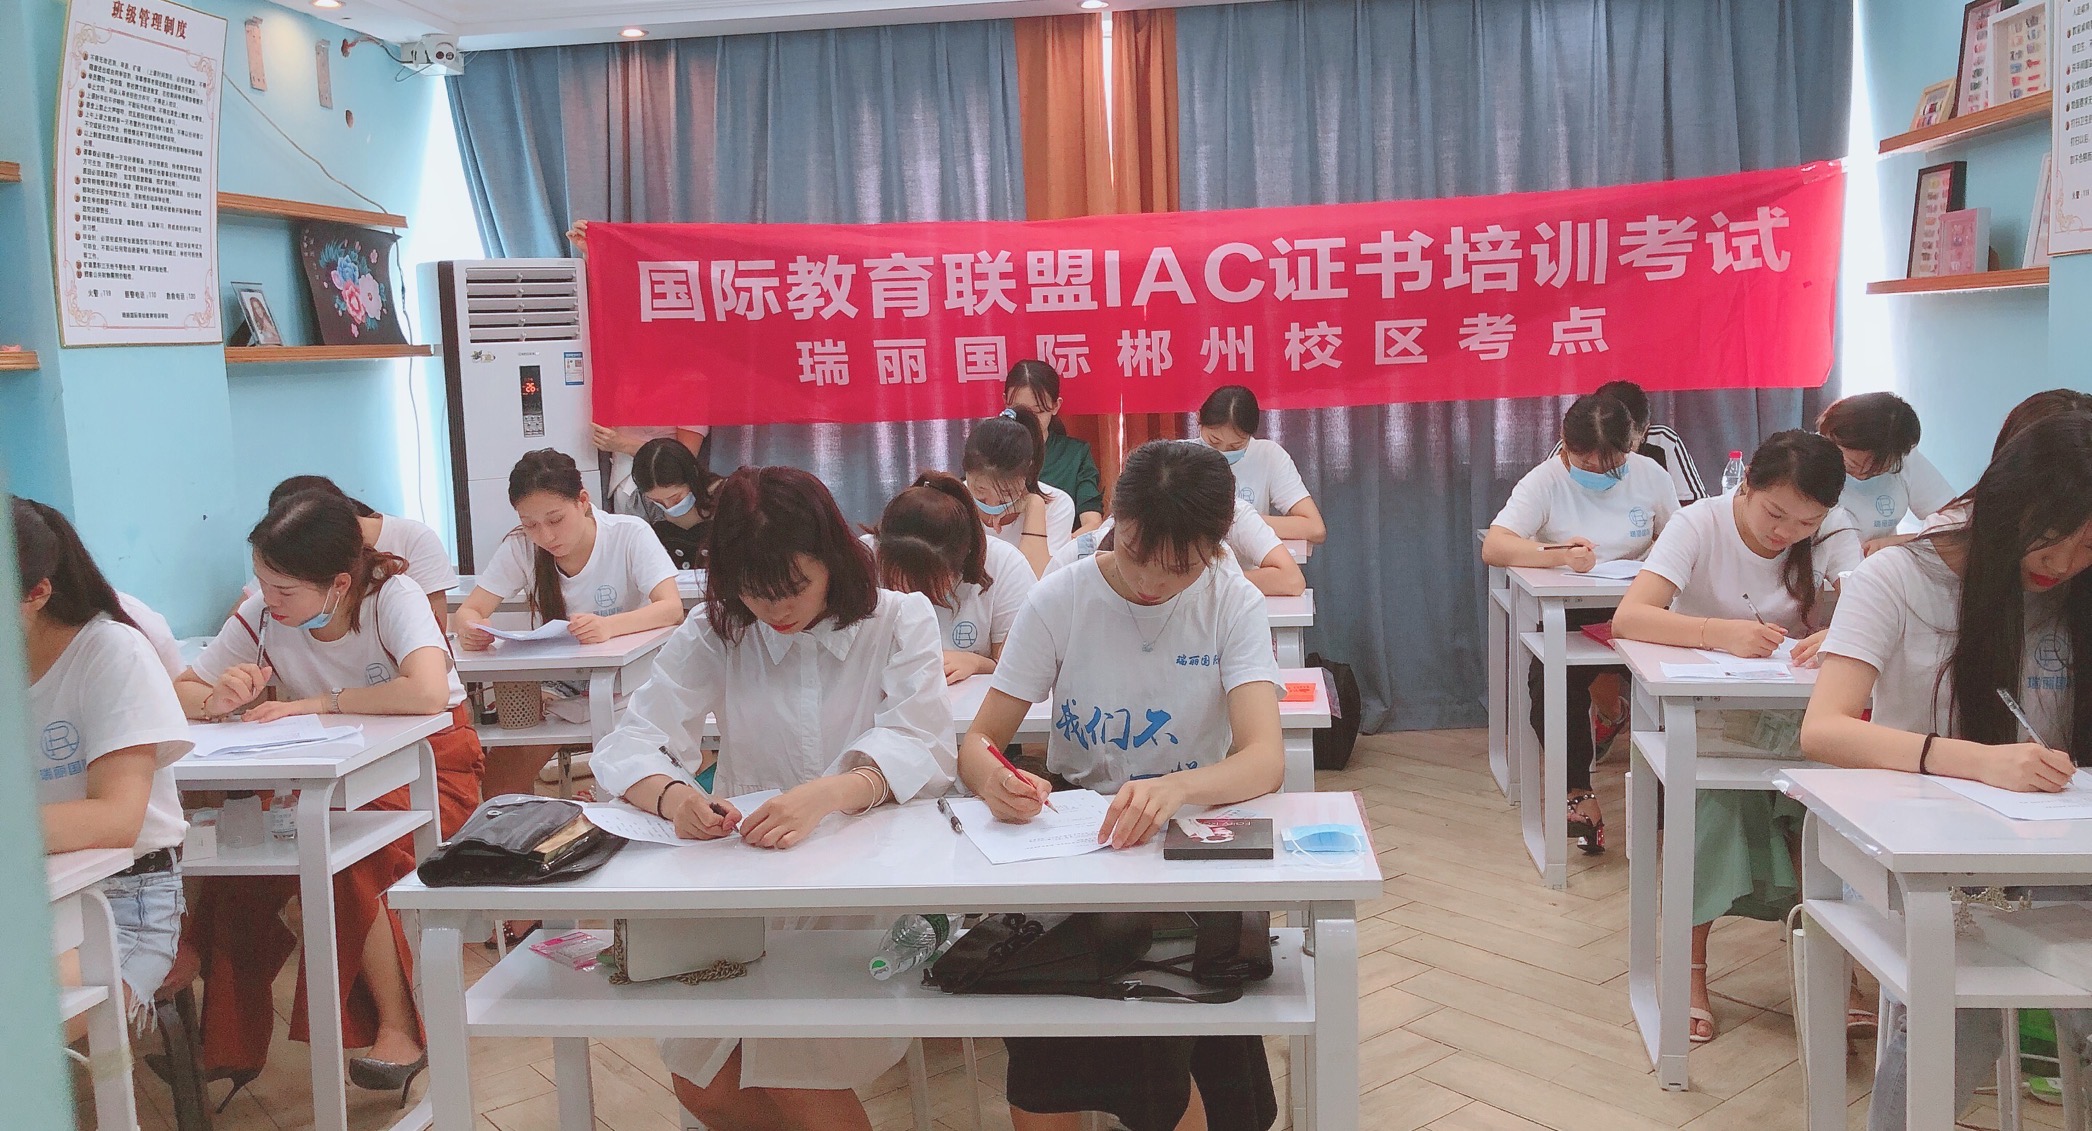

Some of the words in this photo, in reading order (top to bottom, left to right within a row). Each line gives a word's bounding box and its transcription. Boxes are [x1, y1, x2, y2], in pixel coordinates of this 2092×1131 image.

[111, 1, 187, 39] 班级管理制度
[637, 205, 1791, 323] 国际教育联盟IAC证书培训考试
[797, 306, 1608, 387] 瑞丽国际郴州校区考点
[1056, 698, 1179, 751] 我们不
